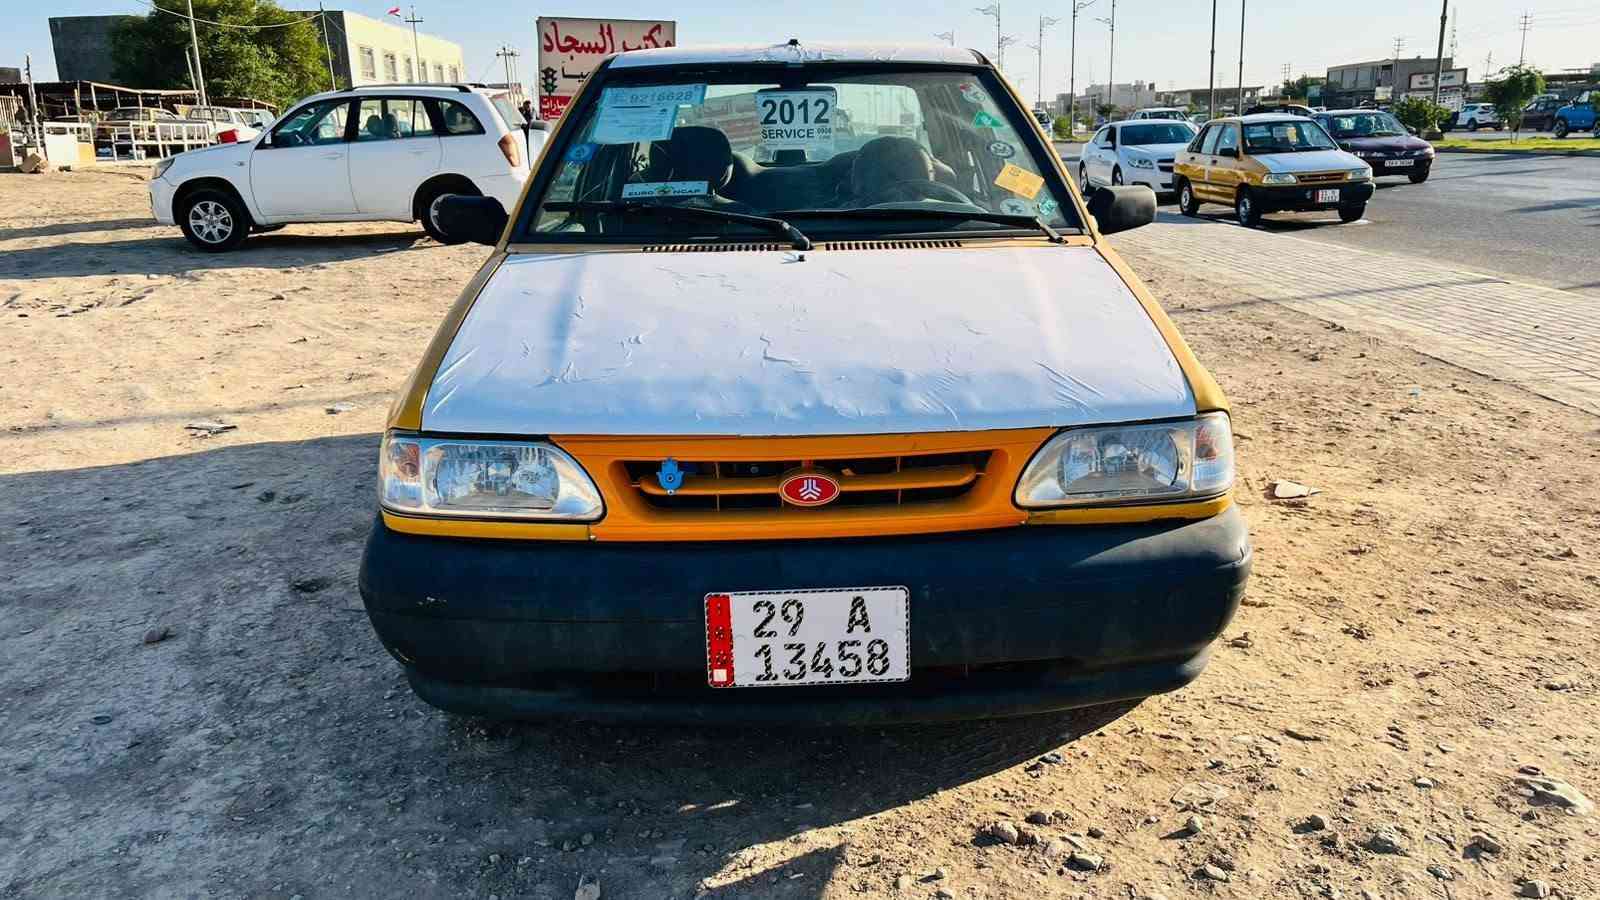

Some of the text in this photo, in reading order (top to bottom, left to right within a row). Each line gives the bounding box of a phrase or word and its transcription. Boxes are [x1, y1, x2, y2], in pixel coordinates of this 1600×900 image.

[543, 21, 614, 61] السجاد
[760, 98, 830, 125] 2012
[760, 128, 815, 139] SERVICE
[753, 599, 804, 638] 29
[846, 596, 871, 633] A
[754, 639, 890, 681] 13458
